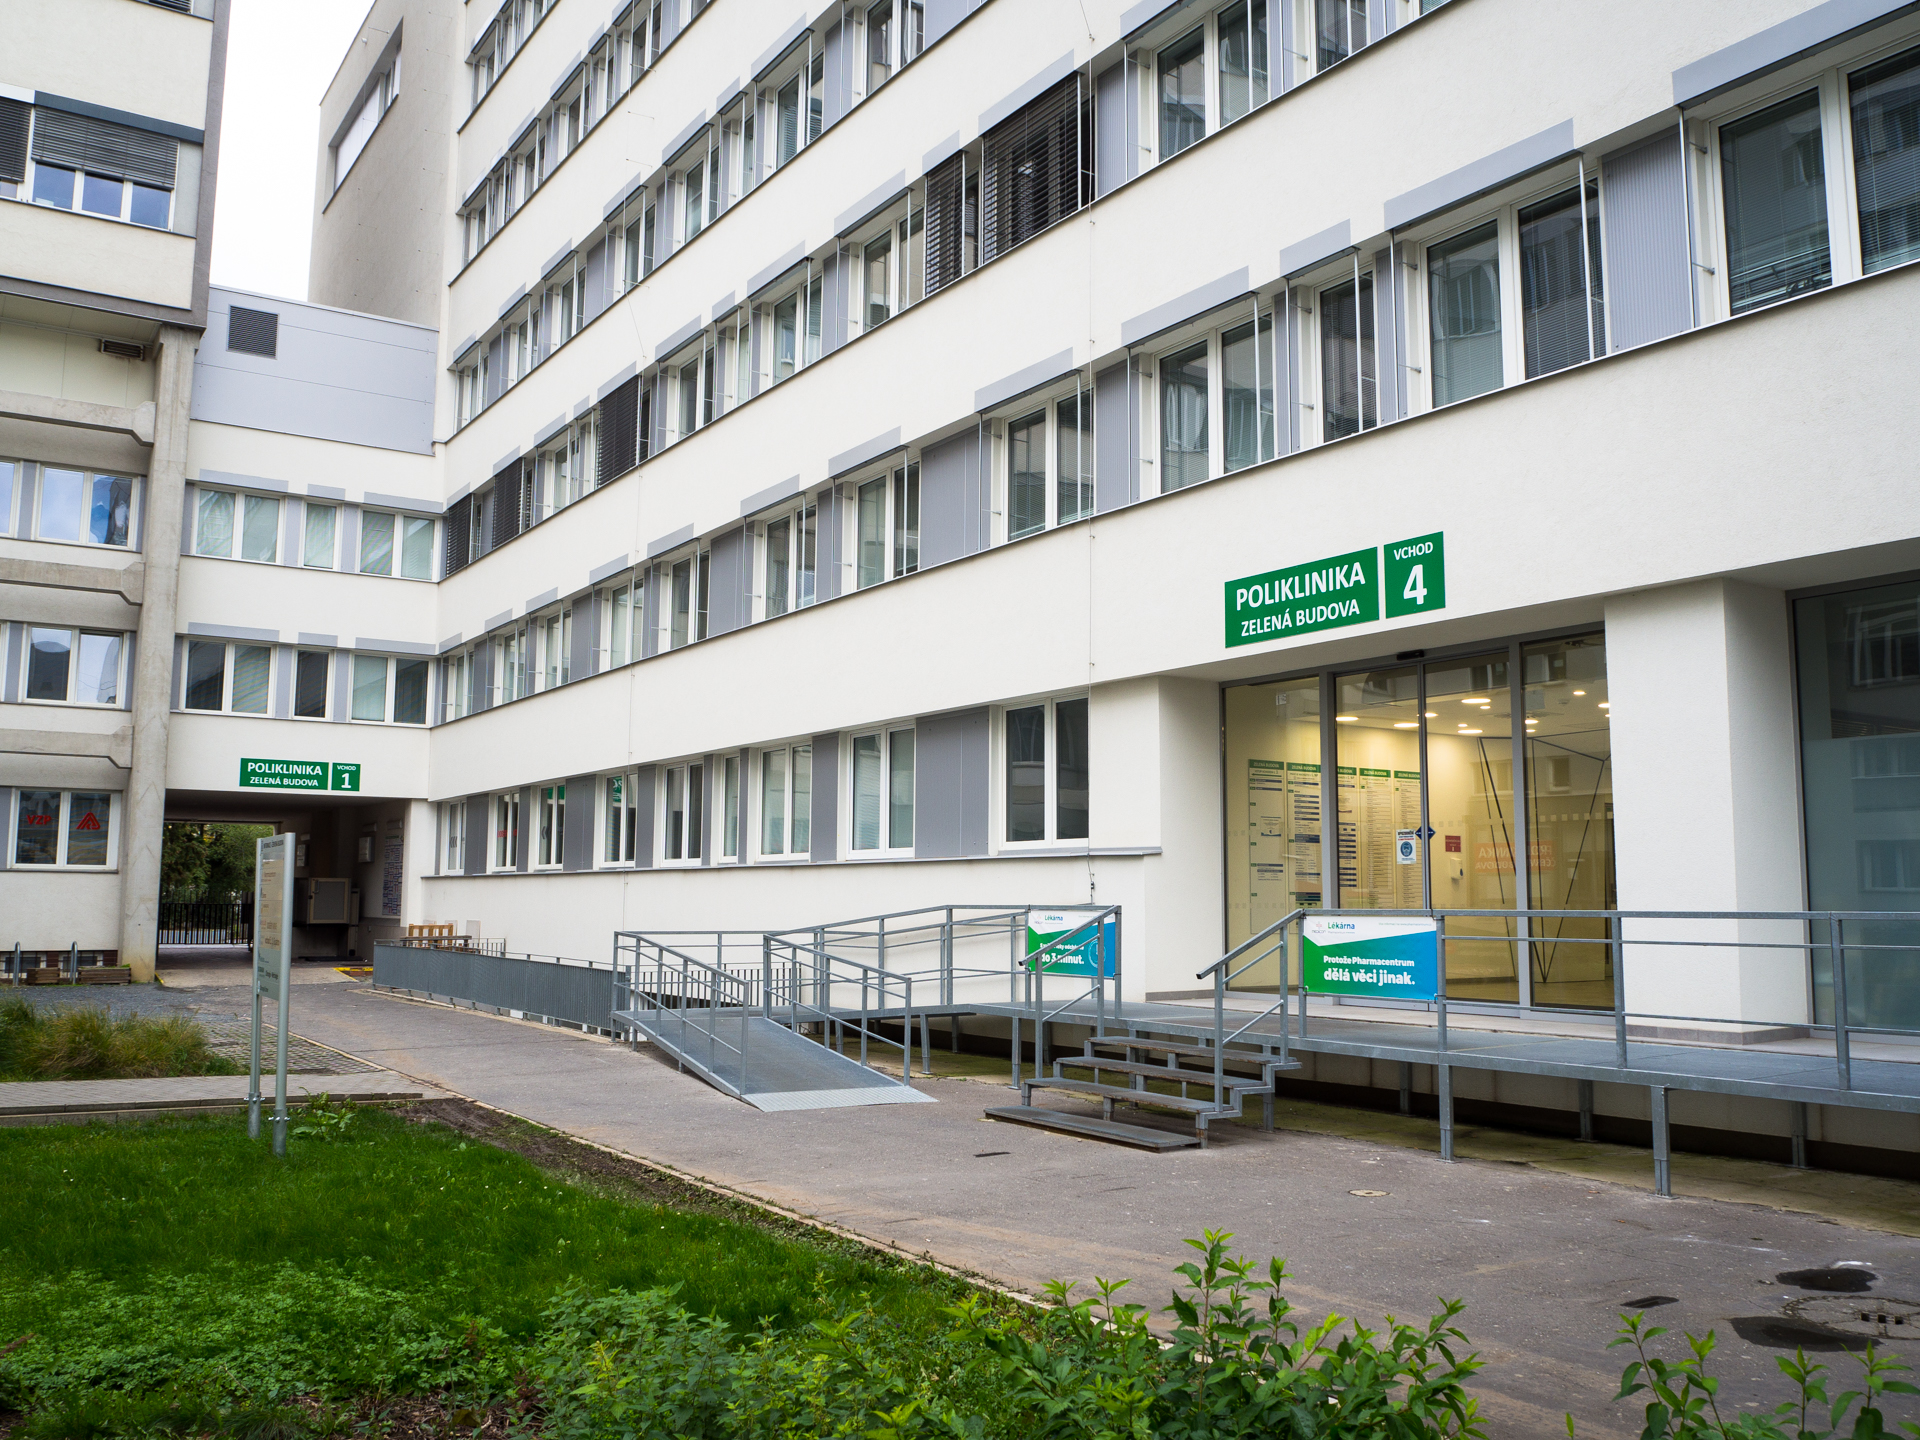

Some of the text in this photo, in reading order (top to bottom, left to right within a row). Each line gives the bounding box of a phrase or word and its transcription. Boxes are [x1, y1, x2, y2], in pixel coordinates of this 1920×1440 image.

[1394, 542, 1433, 560] VCHOD
[1236, 562, 1365, 611] POLIKLINIKA
[1403, 564, 1427, 605] 4
[1241, 598, 1360, 637] ZELENÁ BUDOVA
[247, 762, 322, 775] POLIKLINIKA
[250, 776, 318, 786] ZELENÁ BUDOVA
[341, 773, 351, 788] 1
[26, 815, 52, 825] VZP
[1328, 921, 1355, 930] Lékárna
[1051, 953, 1057, 962] 3
[1057, 953, 1084, 964] minut.
[1323, 955, 1414, 967] Protože Pharmacentrum
[1324, 968, 1415, 986] dělá věci jinak.
